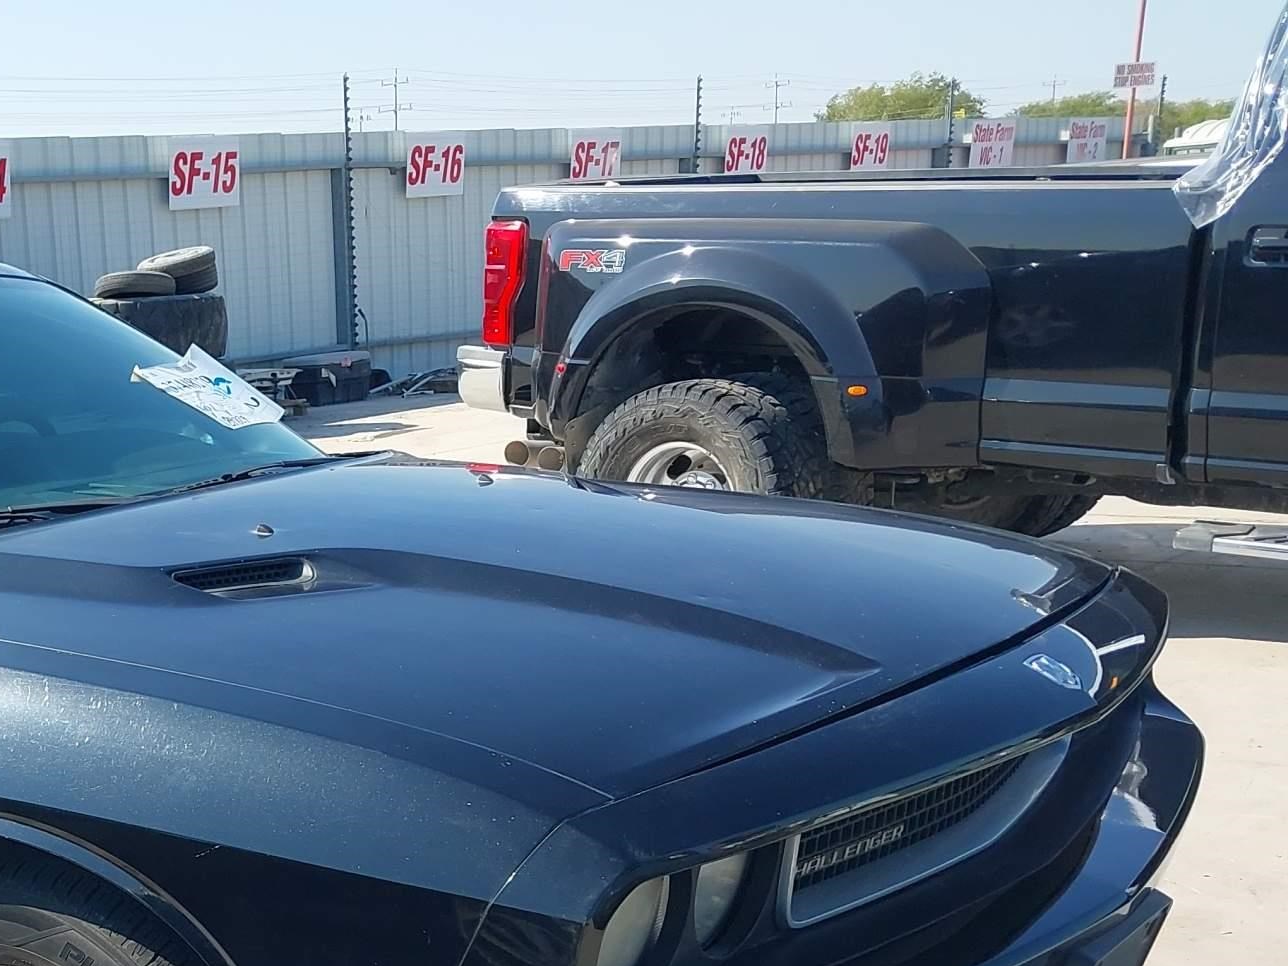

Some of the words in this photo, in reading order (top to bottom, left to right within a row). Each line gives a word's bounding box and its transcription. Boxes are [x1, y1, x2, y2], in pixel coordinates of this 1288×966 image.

[1114, 76, 1129, 87] STOP
[1130, 74, 1155, 87] ENGINES
[1116, 64, 1126, 75] NO
[1127, 63, 1155, 75] SMOKING
[974, 124, 994, 143] State
[995, 123, 1015, 141] Farm
[1071, 122, 1089, 140] State
[1089, 121, 1106, 139] Farm
[572, 141, 620, 179] SF-17
[725, 136, 767, 173] SF-18
[852, 132, 889, 167] SF-19
[979, 146, 992, 165] VIC
[171, 150, 237, 197] SF-15
[407, 143, 464, 187] SF-16
[559, 249, 626, 272] FX4
[793, 824, 905, 876] HALLENGER
